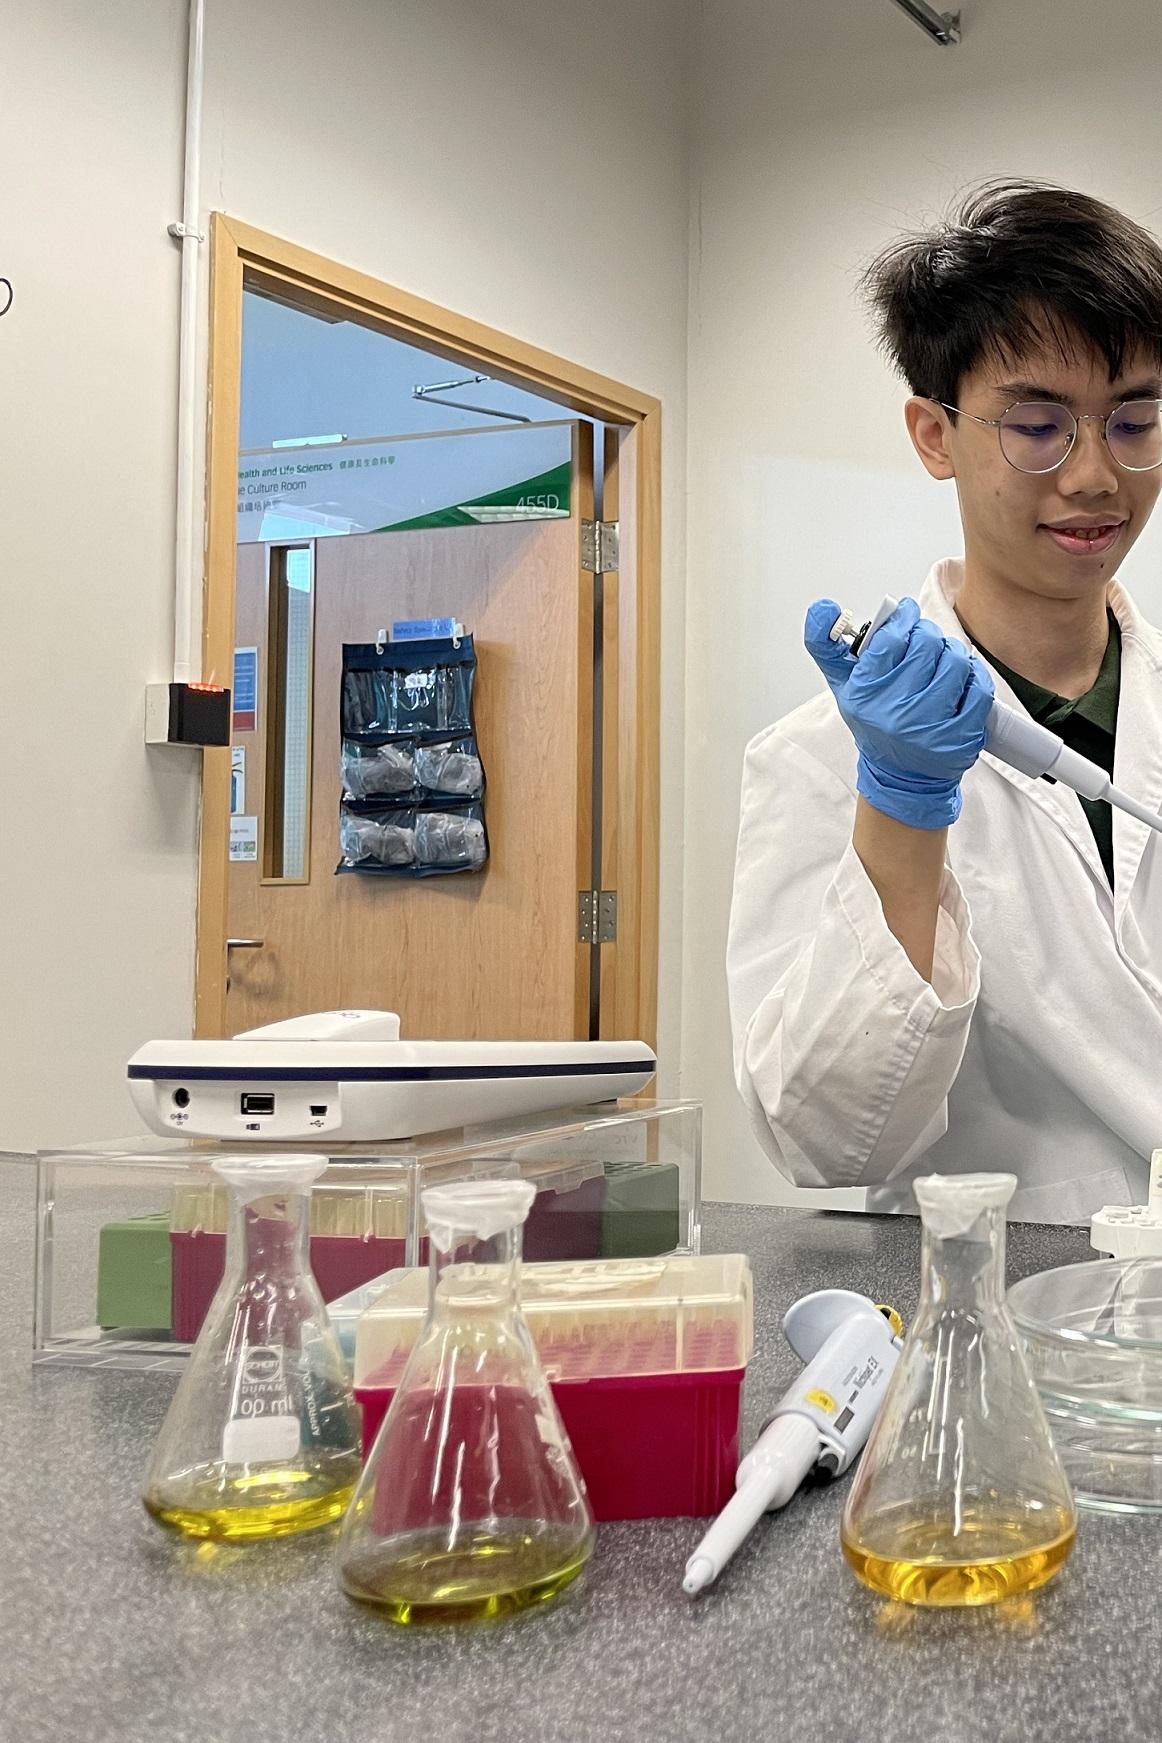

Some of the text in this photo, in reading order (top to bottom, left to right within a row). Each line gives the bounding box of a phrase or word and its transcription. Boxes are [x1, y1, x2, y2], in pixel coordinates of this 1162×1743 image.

[238, 462, 333, 480] ealth and Life Sciences
[247, 482, 279, 495] Culture
[281, 480, 307, 492] Room
[515, 494, 560, 513] 455D
[234, 1393, 293, 1415] 00 ml
